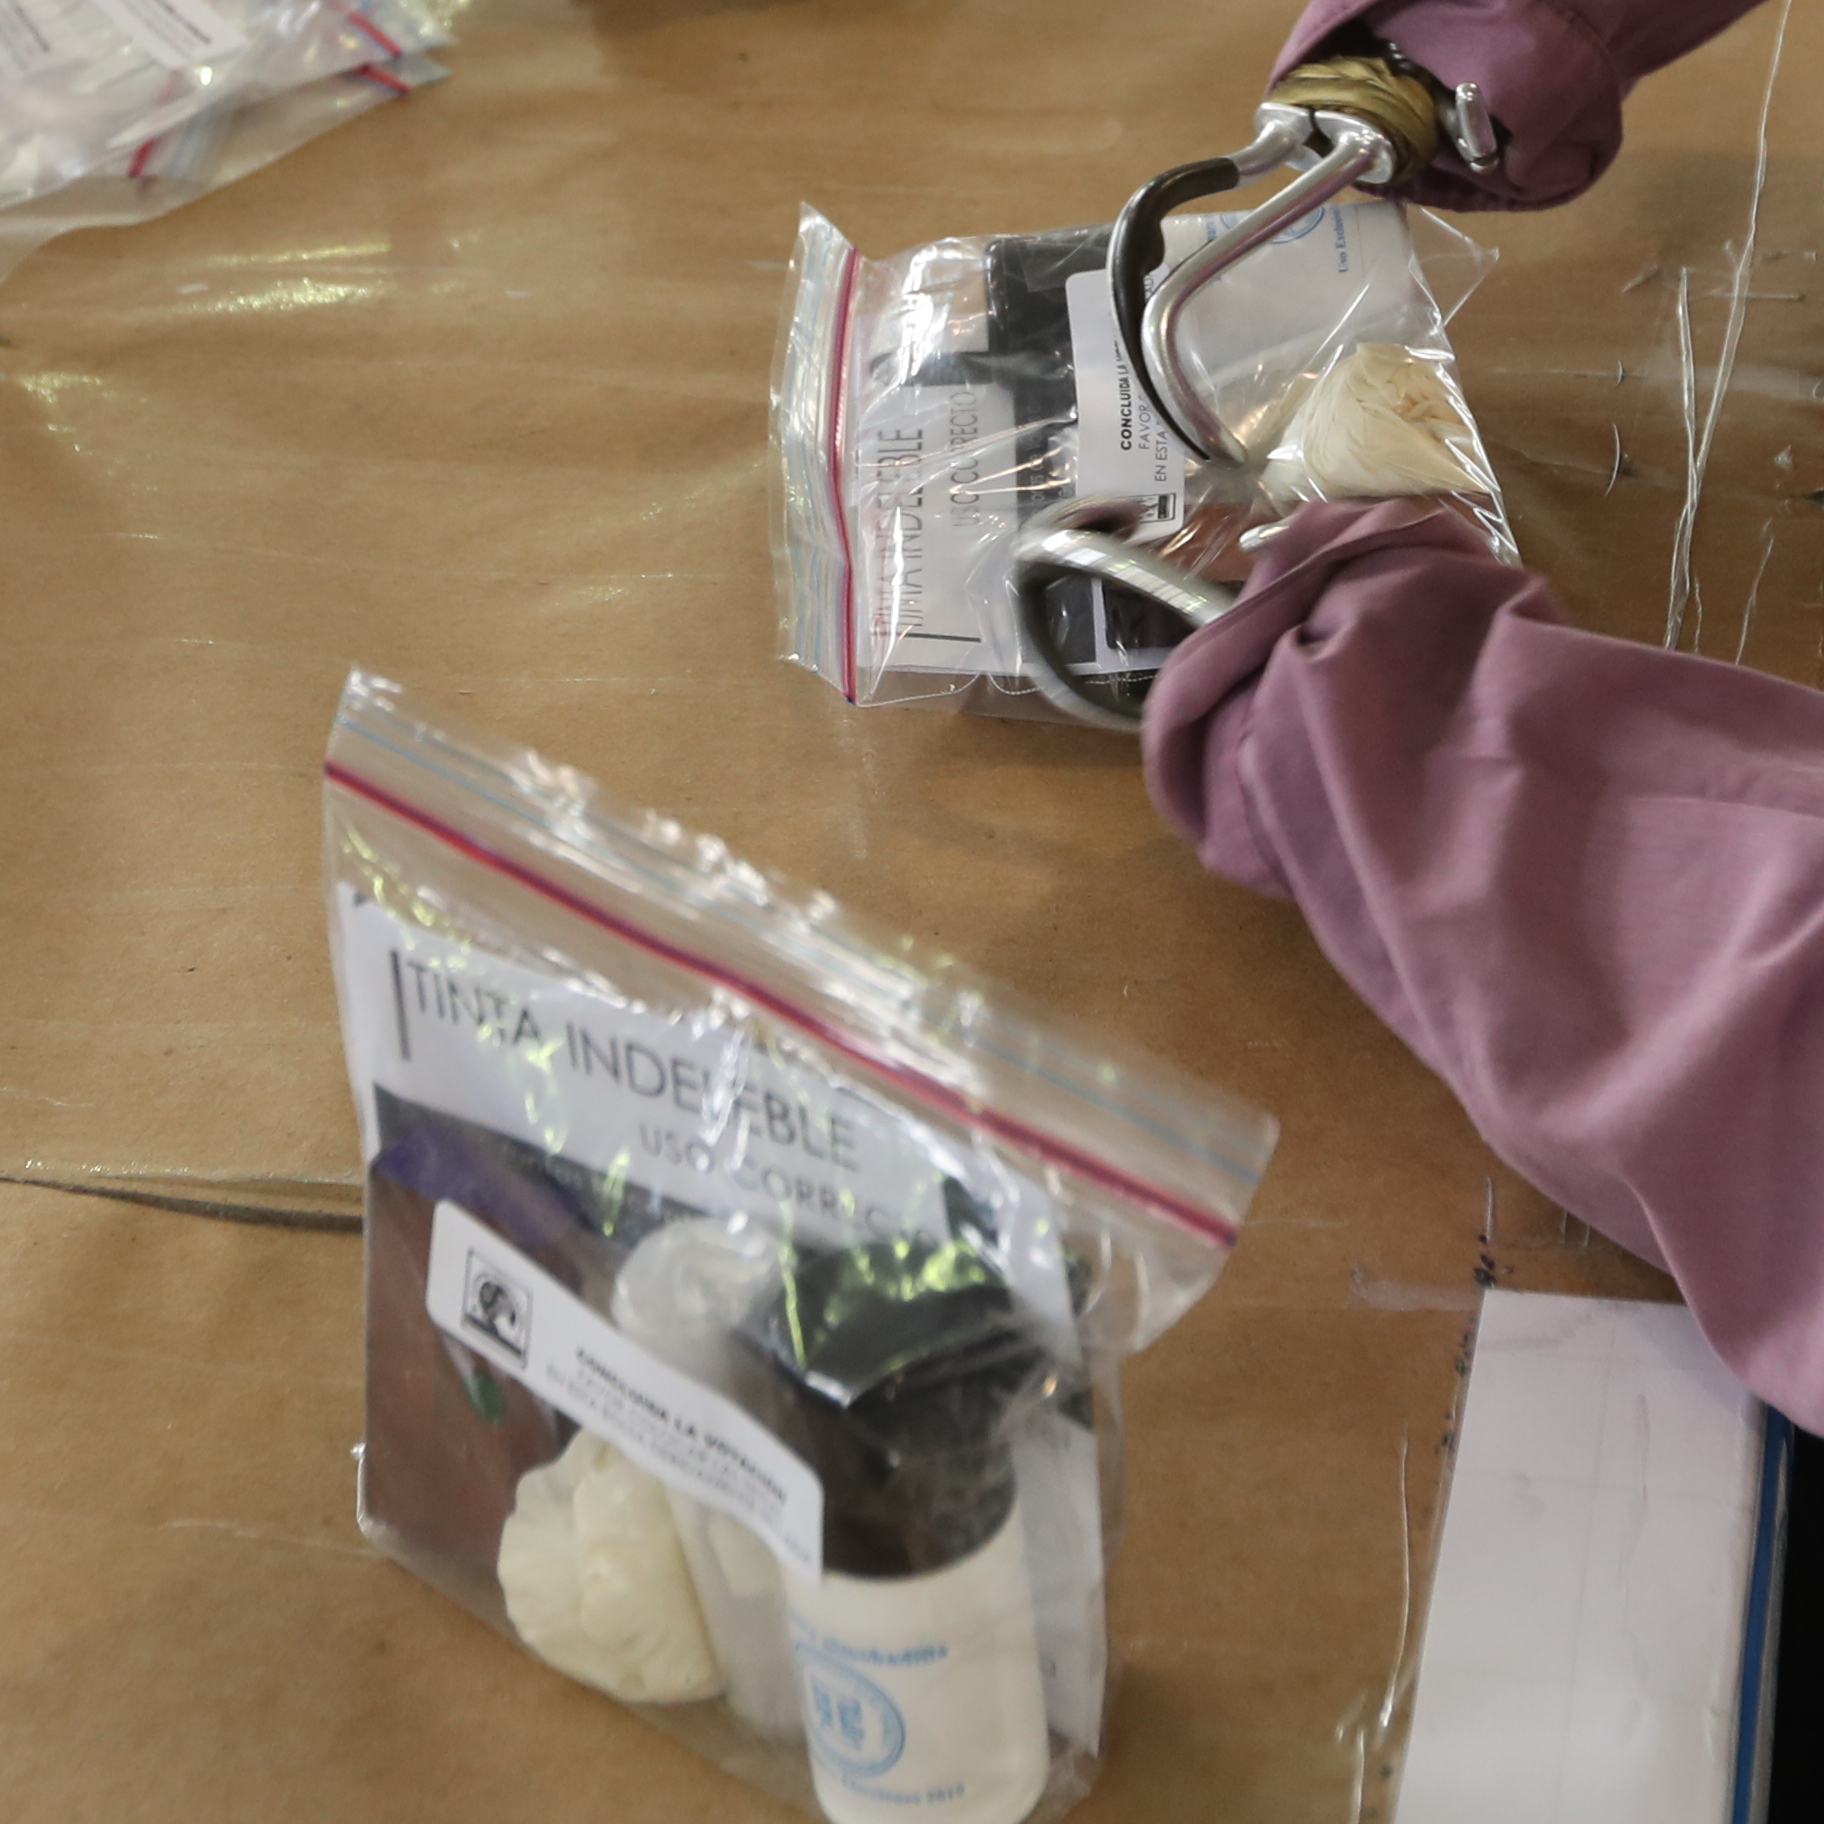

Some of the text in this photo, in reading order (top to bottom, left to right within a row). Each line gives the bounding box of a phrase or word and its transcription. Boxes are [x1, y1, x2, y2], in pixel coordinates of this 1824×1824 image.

[1338, 252, 1349, 273] Uso
[950, 392, 978, 484] CORECTO
[1120, 377, 1132, 450] CONCLUIDA
[1139, 403, 1151, 450] FAVOR
[1155, 430, 1168, 482] EN ESTA
[407, 958, 543, 1047] TINTA
[641, 1124, 716, 1171] USO
